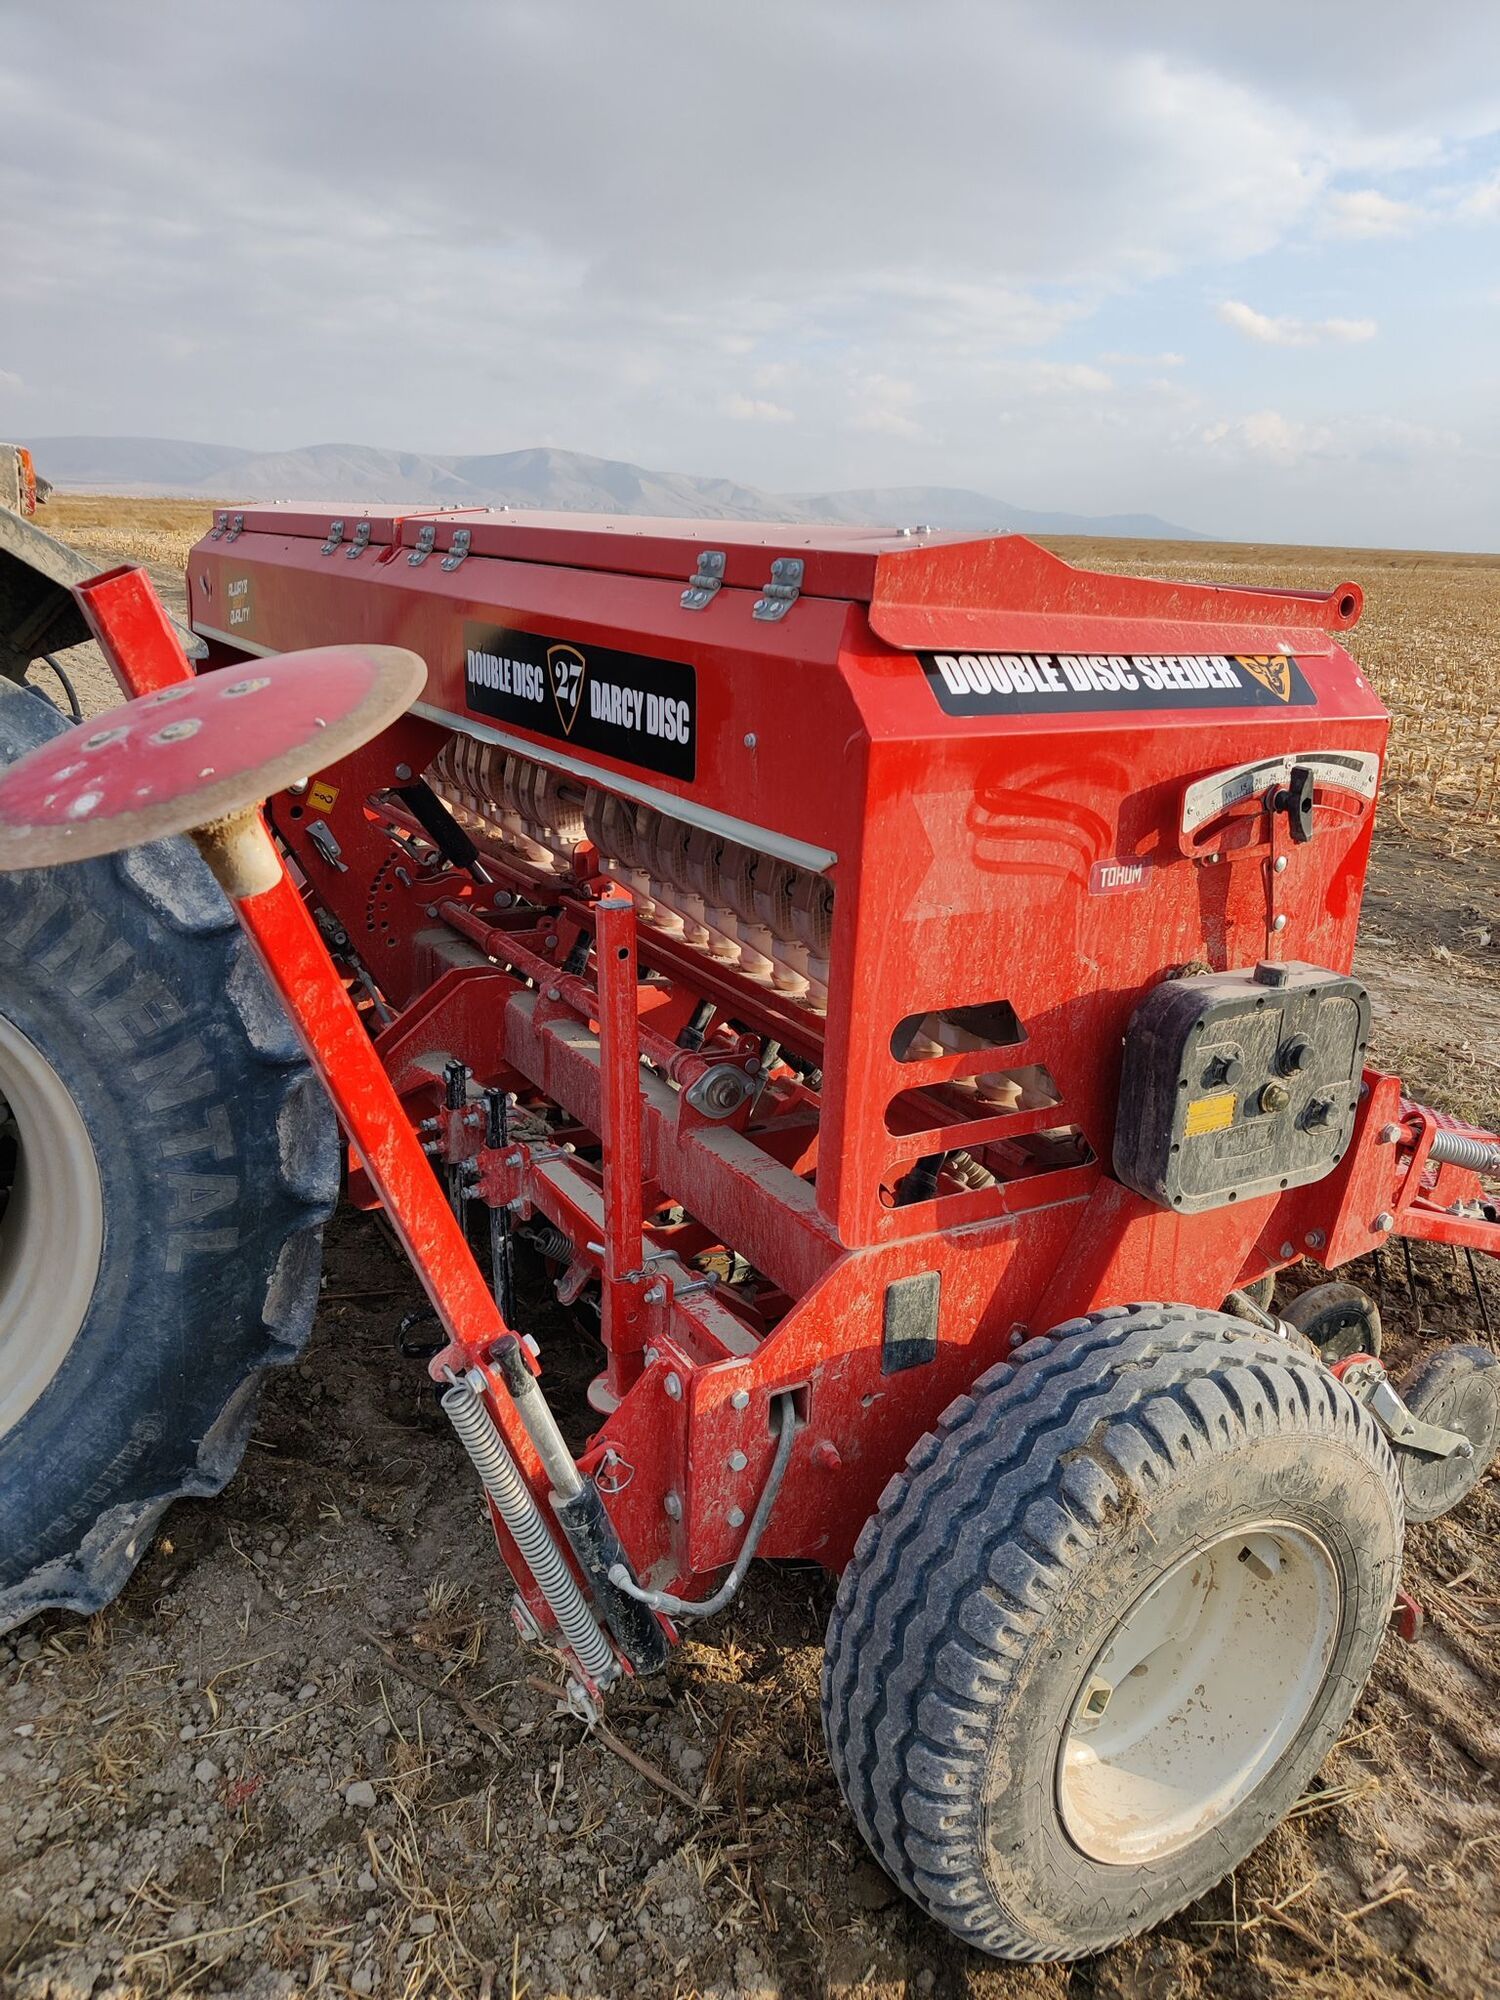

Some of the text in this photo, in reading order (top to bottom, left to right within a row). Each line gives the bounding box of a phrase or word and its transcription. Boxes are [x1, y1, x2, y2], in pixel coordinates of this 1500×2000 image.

[467, 649, 544, 703] DOUBLE DISC
[555, 661, 583, 707] 27
[934, 655, 1243, 695] DOUBLE DISC SEEDER
[590, 679, 690, 745] DARCY DISC
[1100, 863, 1143, 889] TOHUM
